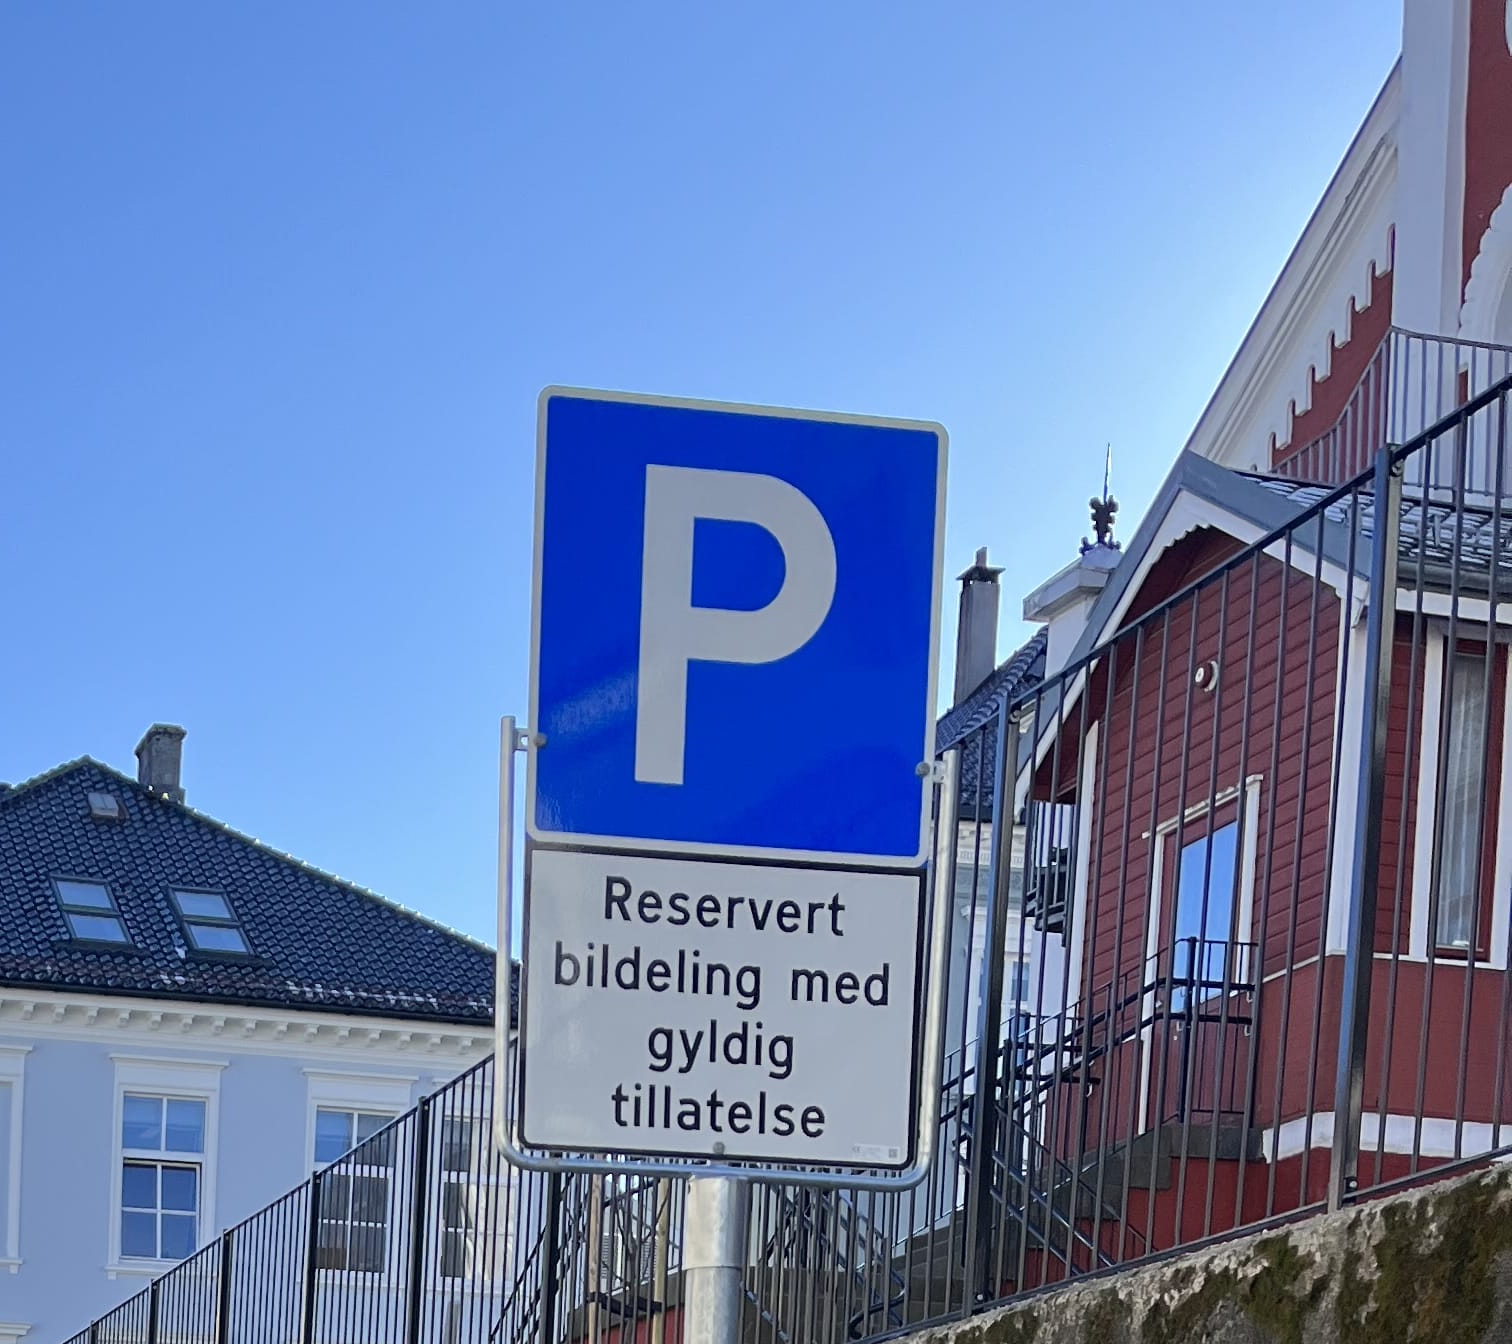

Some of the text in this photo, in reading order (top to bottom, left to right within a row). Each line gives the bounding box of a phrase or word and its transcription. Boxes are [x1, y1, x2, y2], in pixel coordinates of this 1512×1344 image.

[634, 464, 838, 786] P
[604, 875, 845, 938] Reservert
[554, 940, 890, 1010] bildeling med
[646, 1019, 796, 1080] gyldig
[610, 1082, 826, 1140] tillatelse
